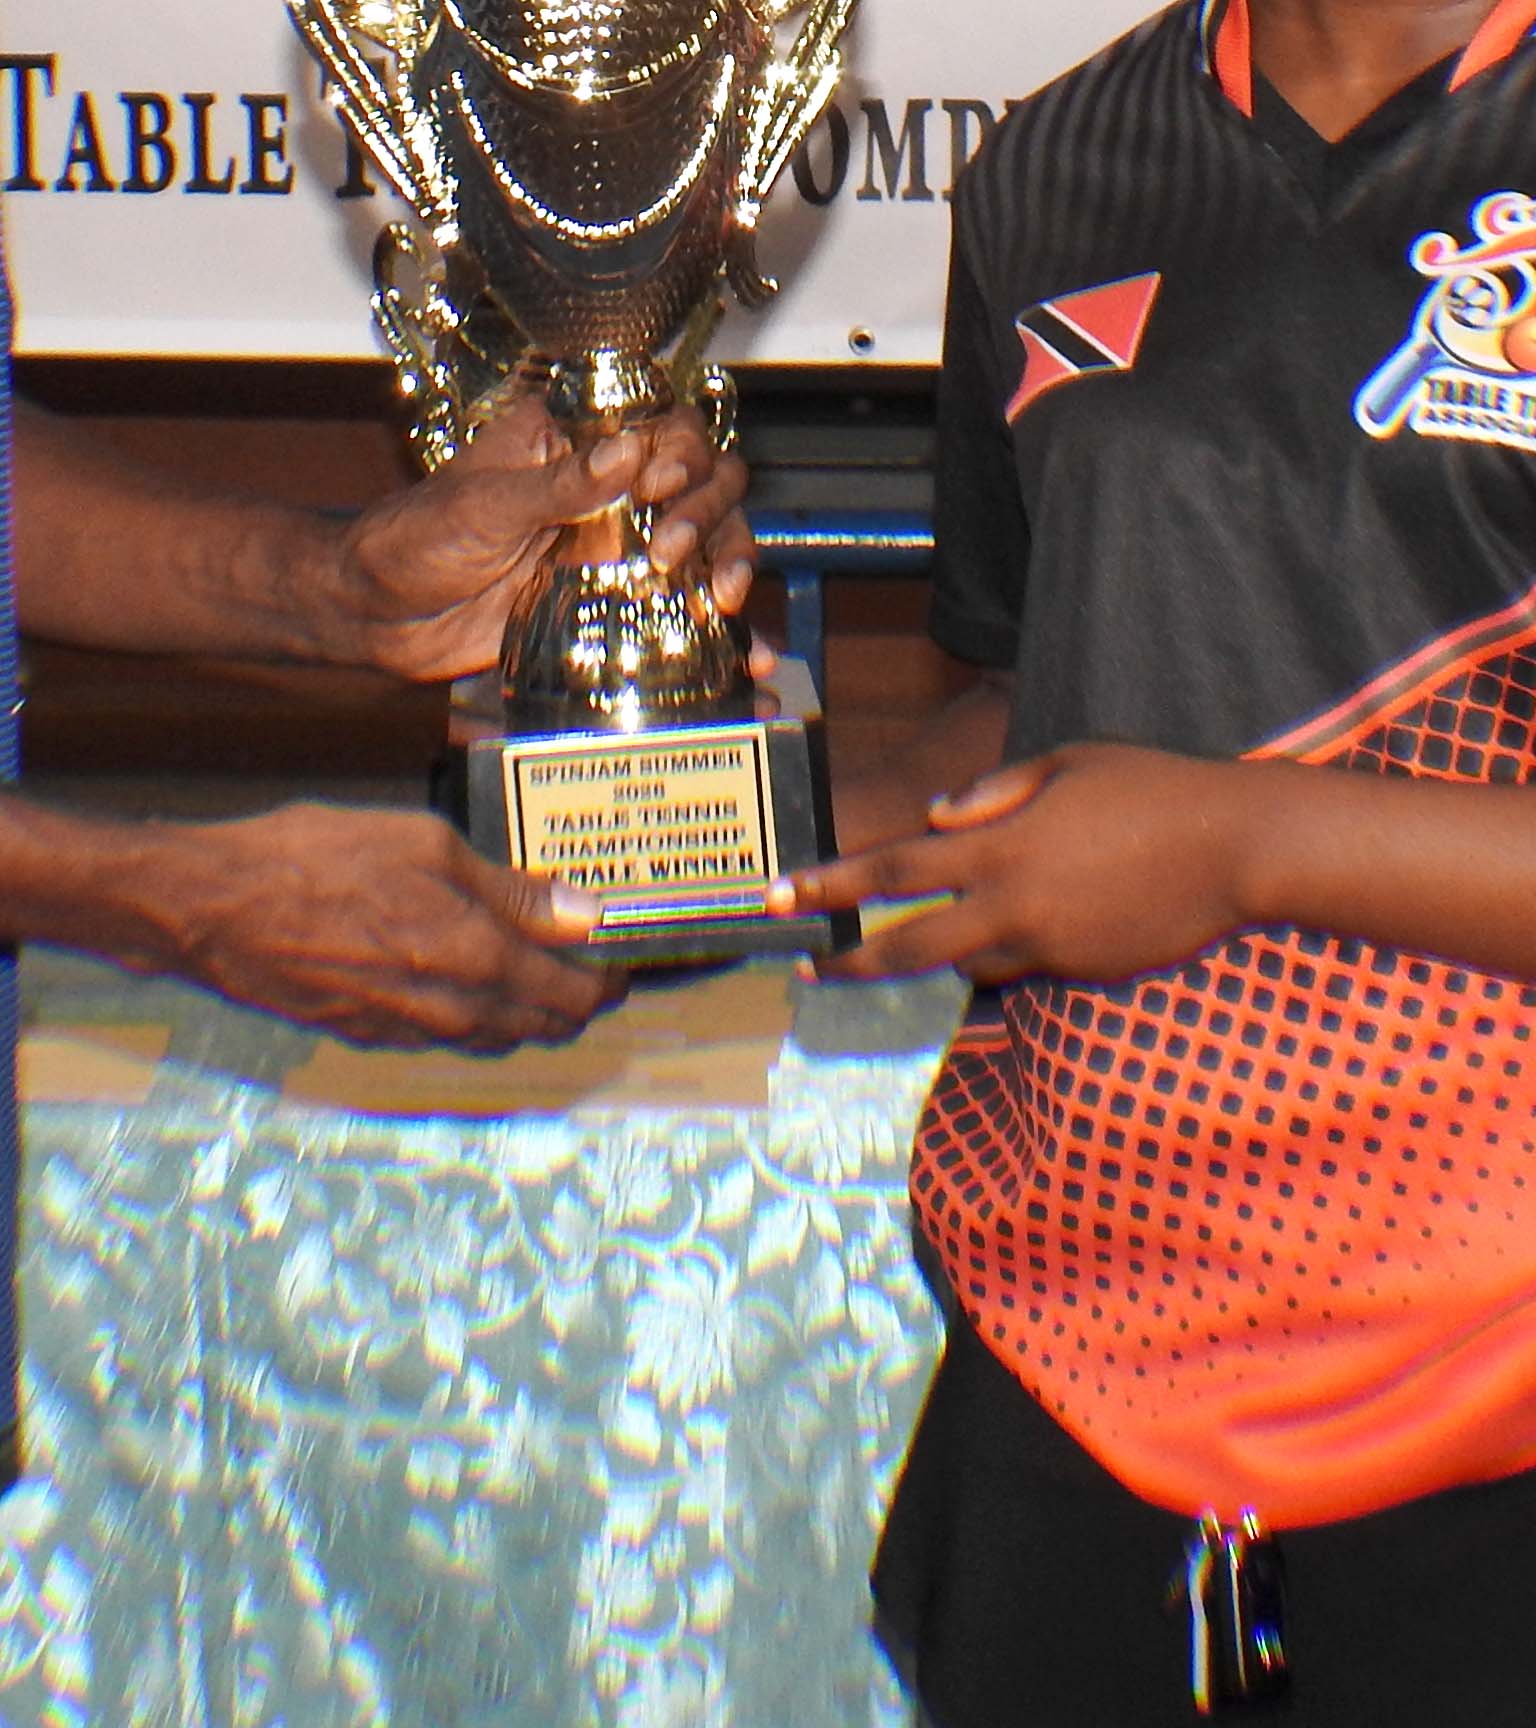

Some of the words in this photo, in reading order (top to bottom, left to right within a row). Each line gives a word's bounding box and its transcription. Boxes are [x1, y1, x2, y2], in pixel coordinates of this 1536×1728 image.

[1425, 377, 1510, 413] TABLE
[530, 758, 632, 786] SPINJAM
[640, 749, 745, 777] SUMMER
[544, 808, 631, 835] TABLE
[637, 799, 739, 827] TENNIS
[540, 823, 747, 863] CHAMPIONSHIP
[649, 850, 756, 882] WINNER
